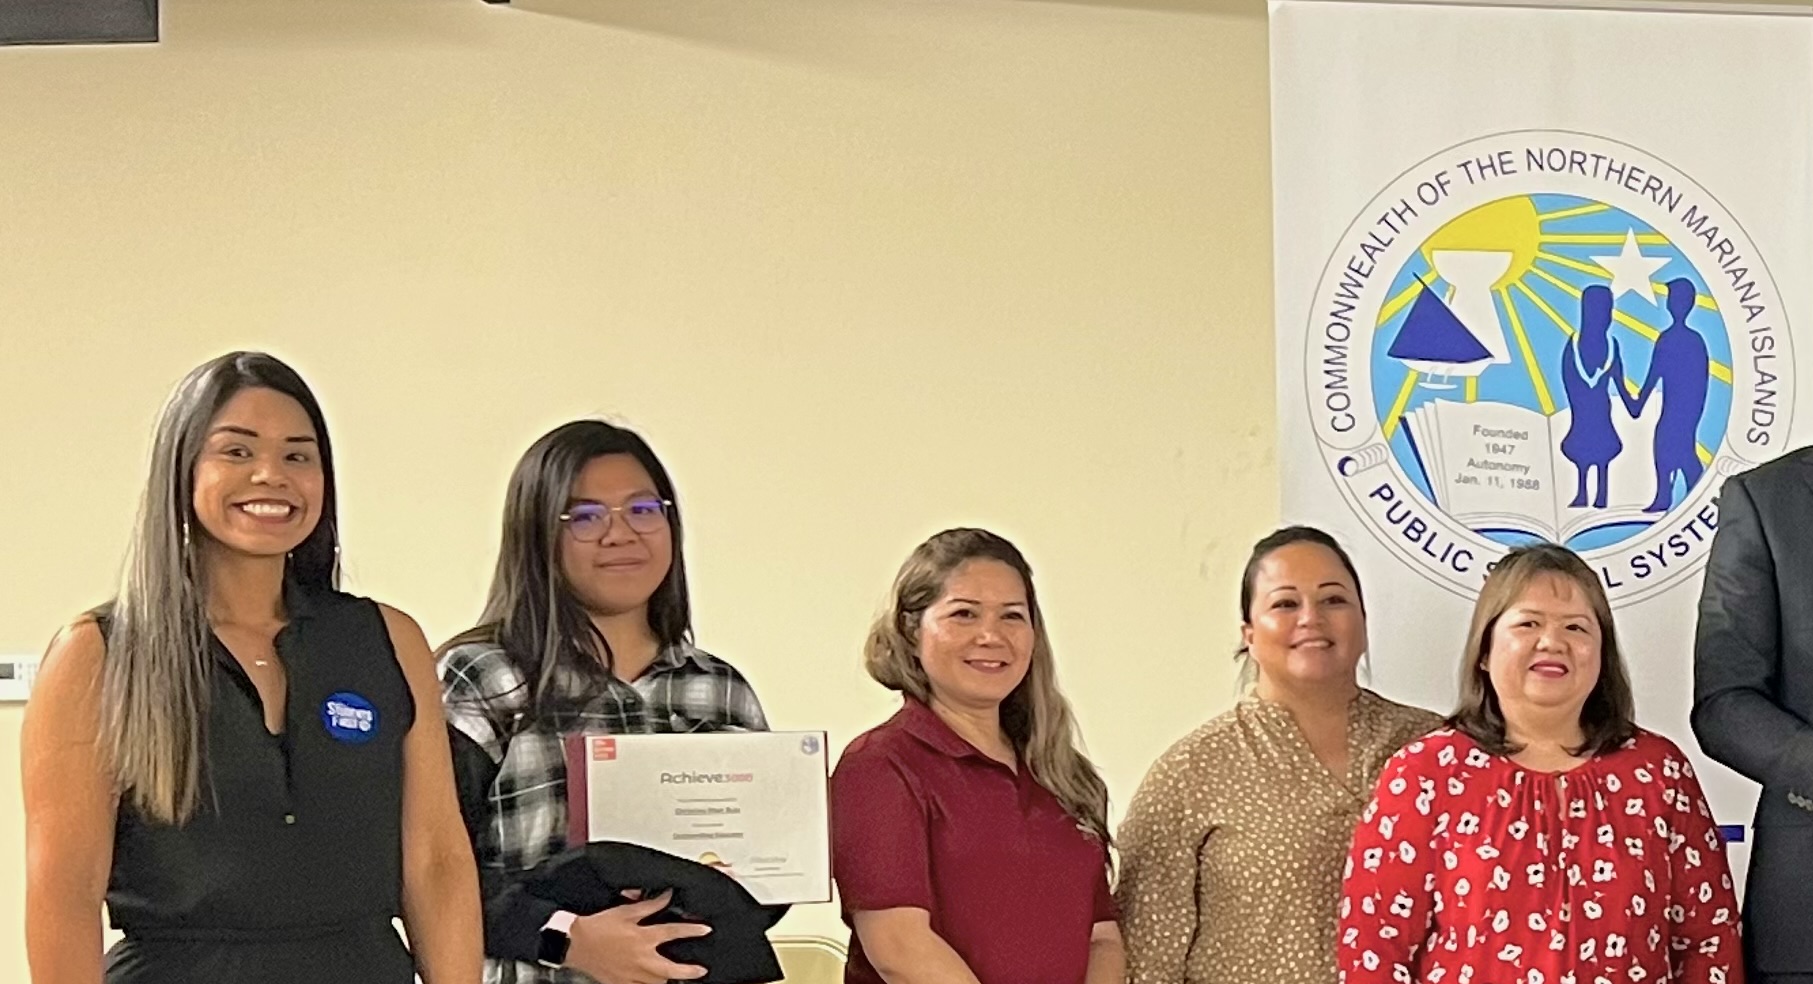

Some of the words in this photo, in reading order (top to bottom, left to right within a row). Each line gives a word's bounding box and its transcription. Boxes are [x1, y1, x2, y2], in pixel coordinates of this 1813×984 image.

[1324, 198, 1418, 433] COMMONWEALTH
[1416, 171, 1451, 206] OF
[1456, 151, 1517, 187] THE
[1526, 147, 1683, 213] NORTHERN
[1680, 205, 1767, 324] MARIANA
[1747, 326, 1778, 447] ISLANDS
[1473, 424, 1528, 440] Founded
[1466, 457, 1530, 475] Autonomy
[1454, 473, 1480, 485] Jan.
[1369, 482, 1474, 573] PUBLIC
[1631, 495, 1721, 578] SYSTE
